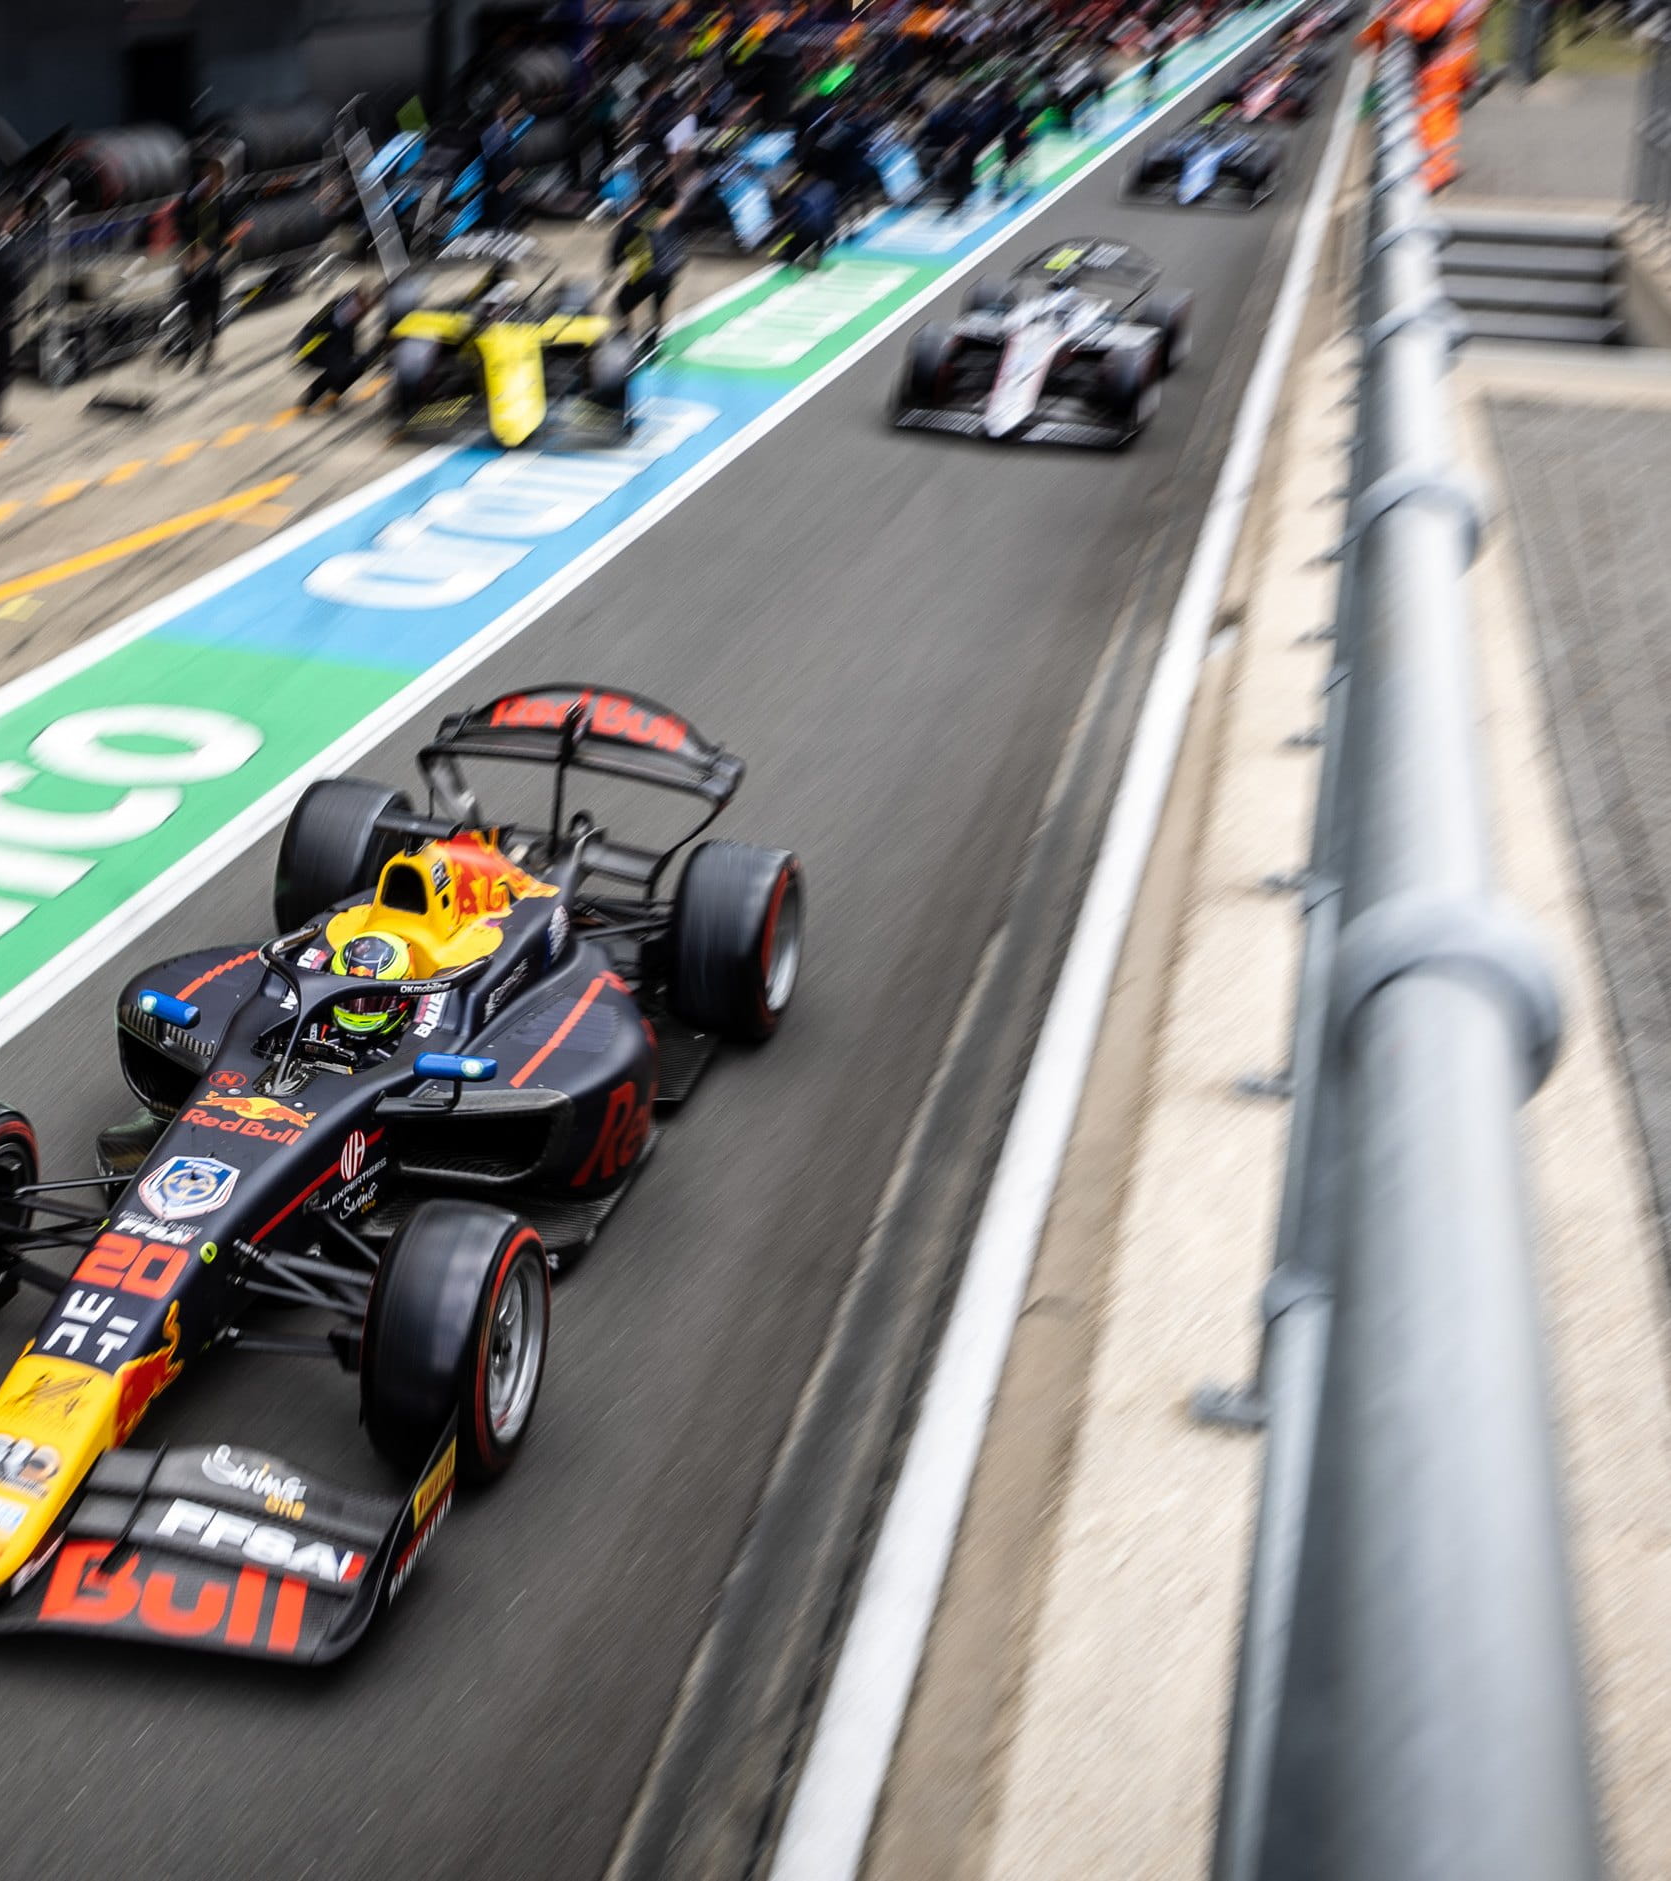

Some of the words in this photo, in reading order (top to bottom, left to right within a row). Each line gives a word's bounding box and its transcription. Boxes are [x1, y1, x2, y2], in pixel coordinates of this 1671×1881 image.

[591, 691, 688, 752] Bull
[180, 1108, 245, 1133] Red
[239, 1119, 304, 1146] Bull
[69, 1231, 190, 1300] 20
[155, 1497, 350, 1583] FFSA
[38, 1539, 309, 1655] Bull
